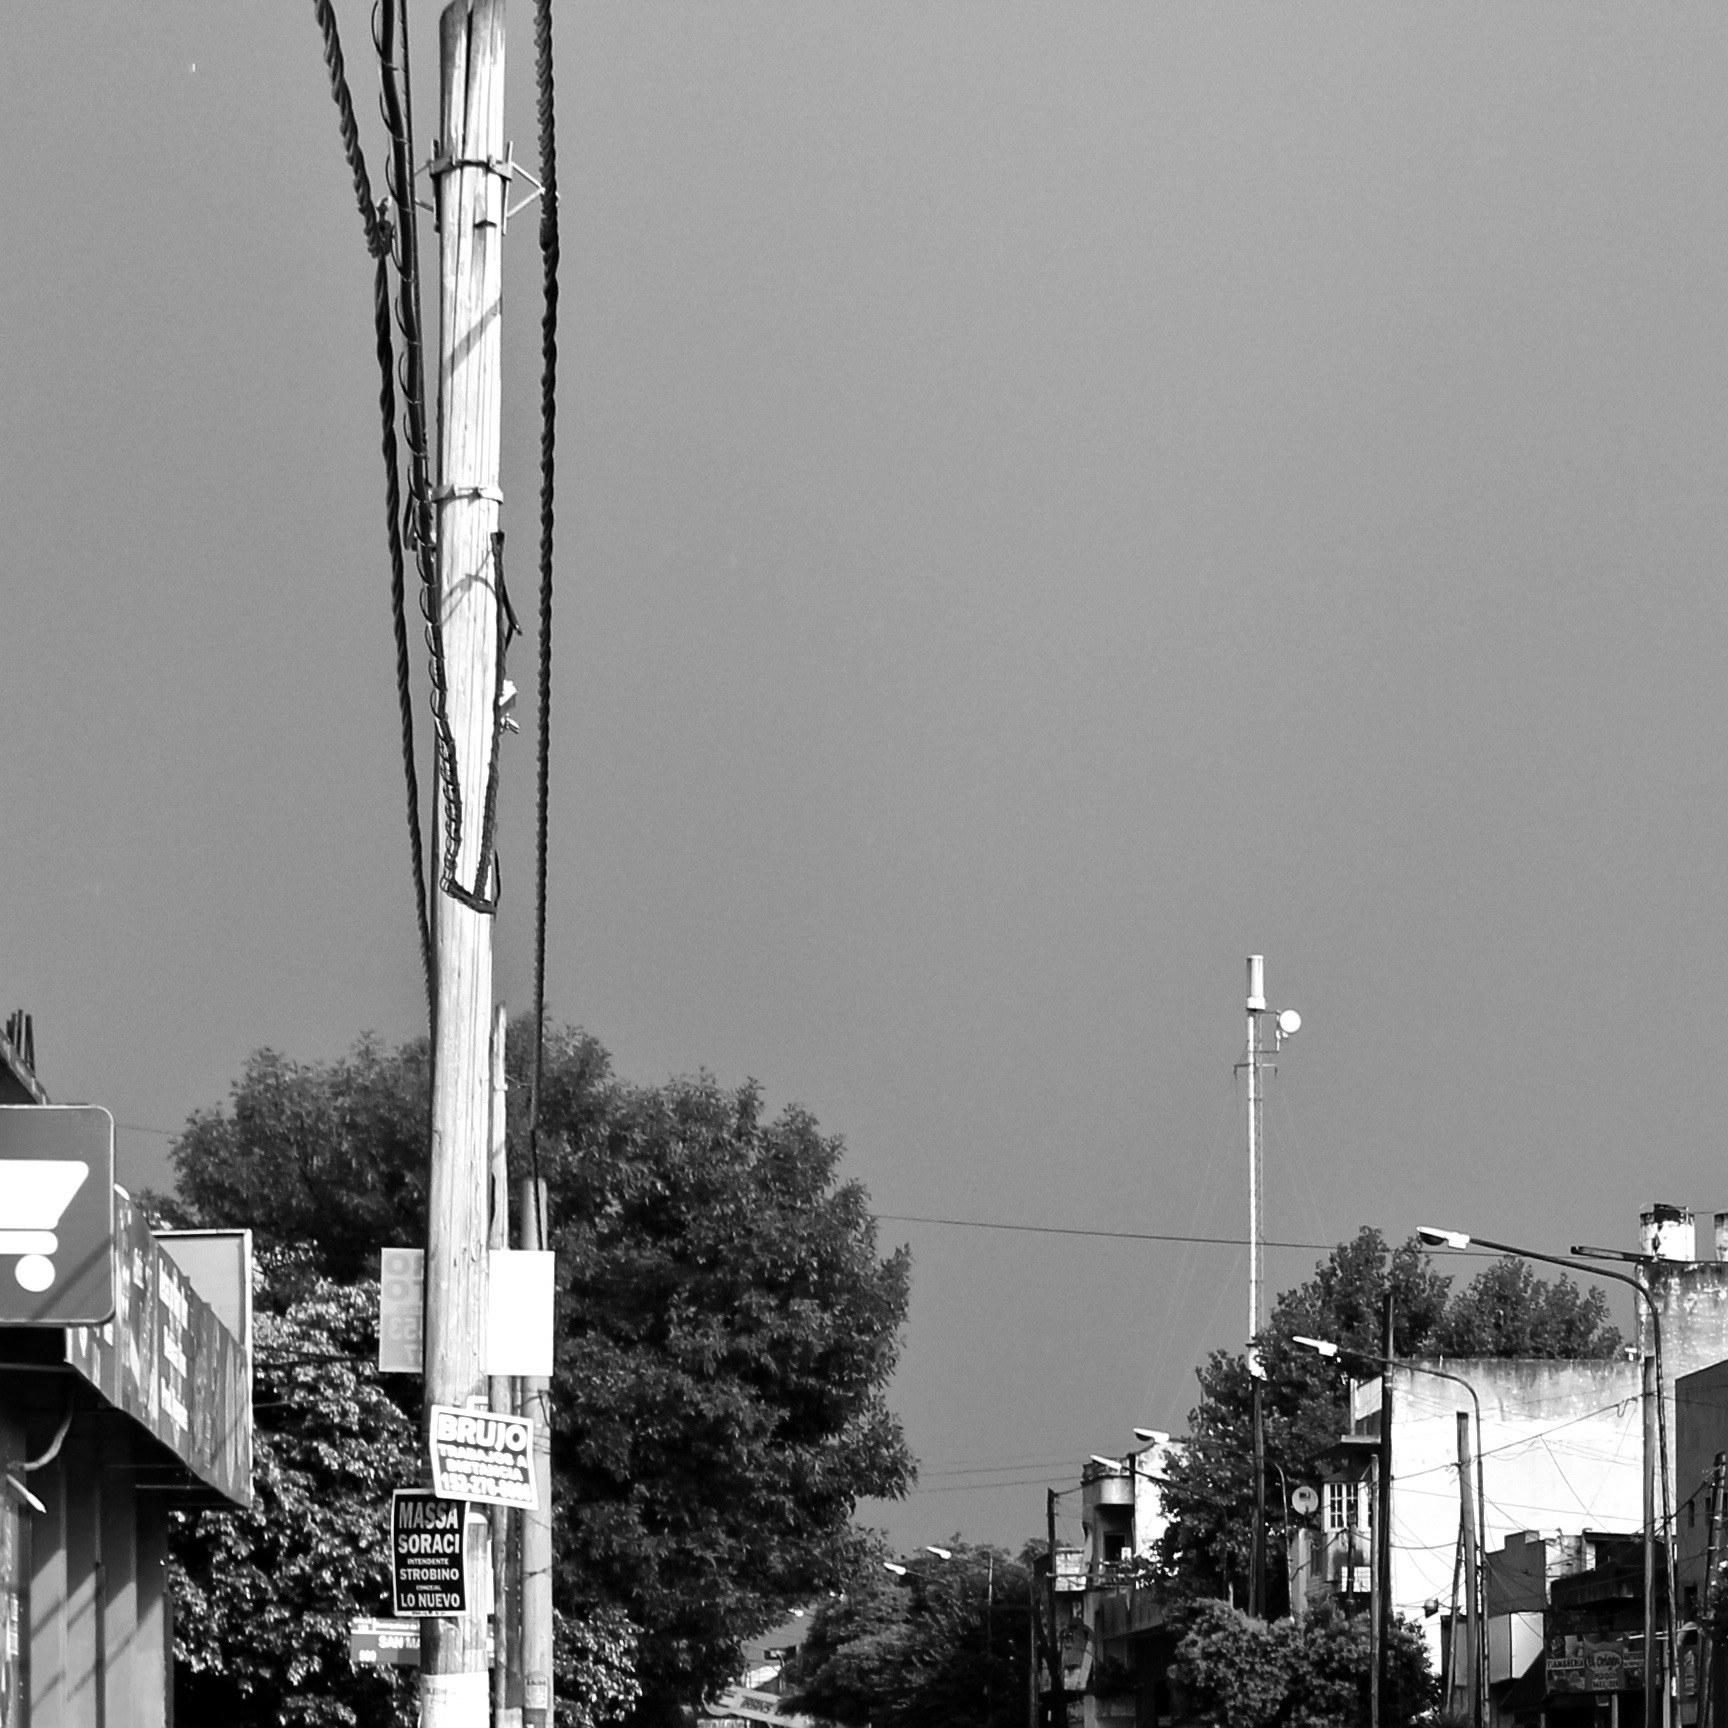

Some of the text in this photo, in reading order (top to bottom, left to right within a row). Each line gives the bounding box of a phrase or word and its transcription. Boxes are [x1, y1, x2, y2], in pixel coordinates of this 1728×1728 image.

[437, 1413, 528, 1452] BRUJO
[398, 1501, 459, 1530] MASSA
[397, 1533, 460, 1555] SORACI
[399, 1568, 460, 1581] STROBINO
[400, 1593, 461, 1608] LO NUEVO
